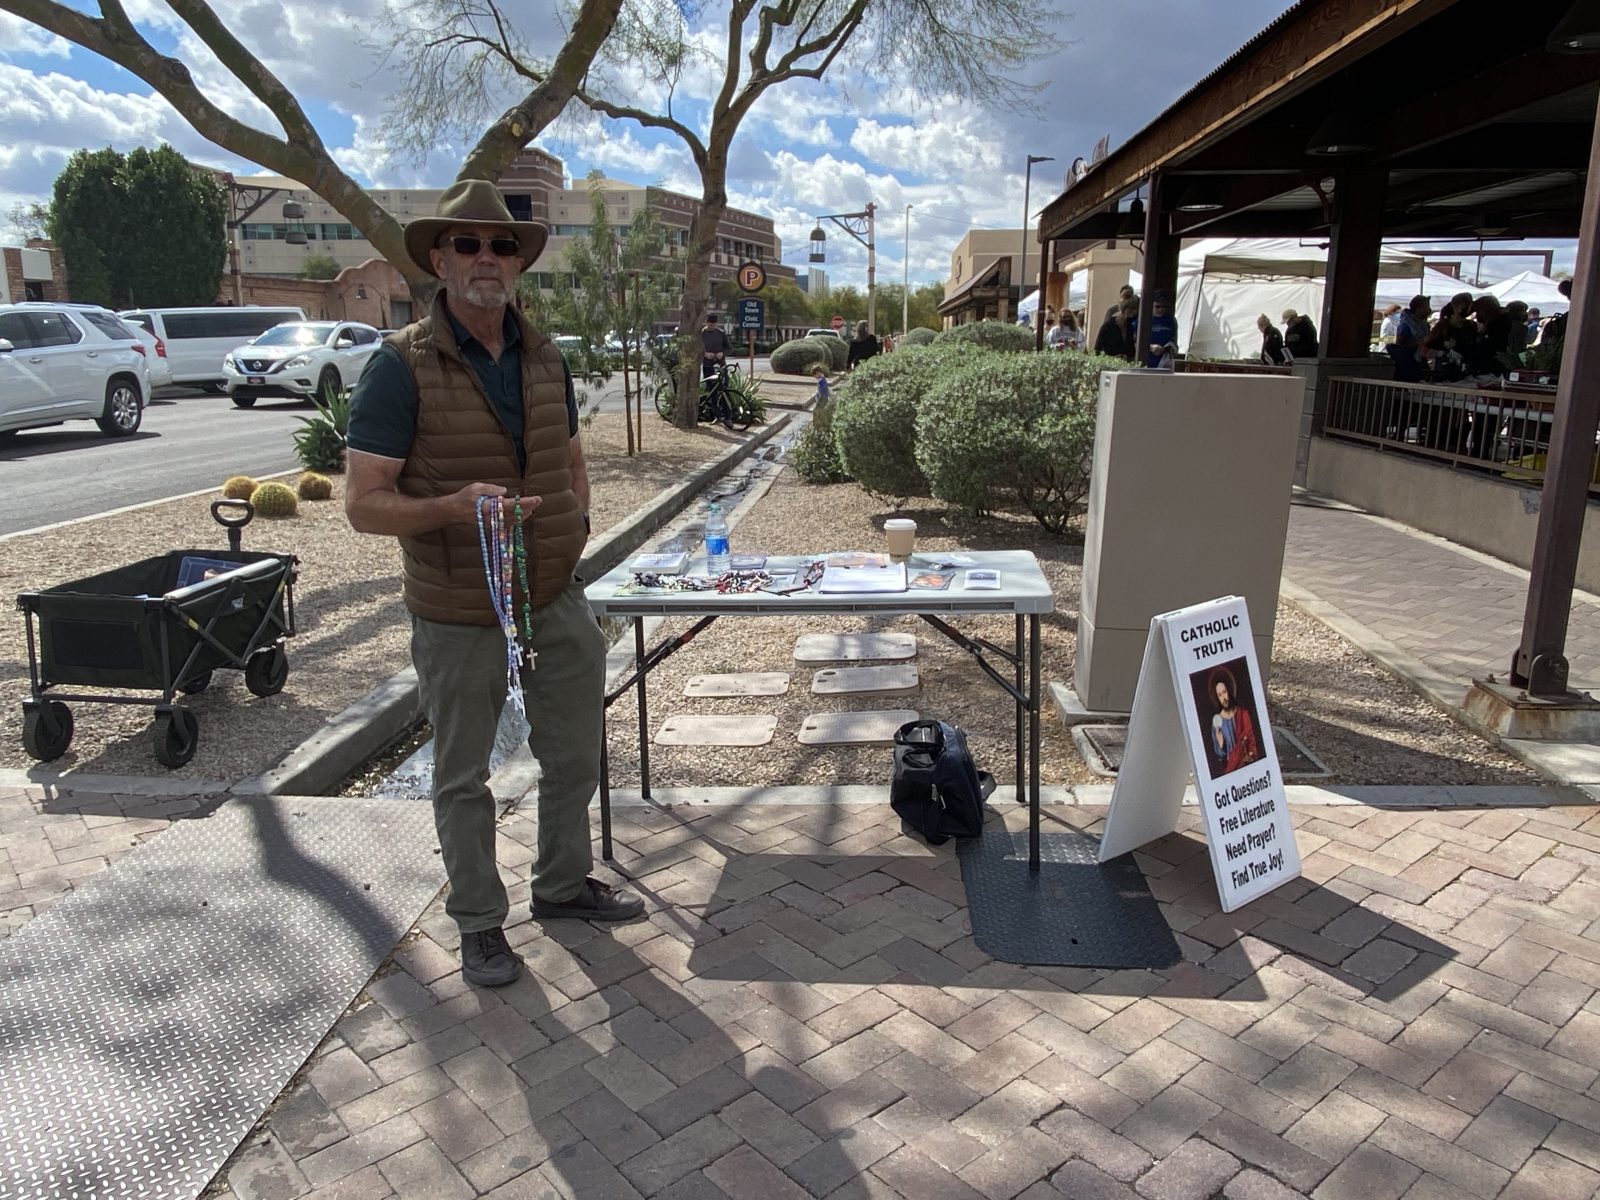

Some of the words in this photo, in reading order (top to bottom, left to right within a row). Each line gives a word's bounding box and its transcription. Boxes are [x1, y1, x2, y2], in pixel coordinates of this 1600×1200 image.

[744, 270, 760, 287] P
[1180, 614, 1240, 643] CATHOLIC
[1192, 636, 1234, 660] TRUTH
[1214, 789, 1231, 809] Got
[1231, 770, 1271, 802] Questions?
[1219, 816, 1239, 835] Free
[1238, 799, 1275, 826] Literature
[1225, 836, 1247, 861] Need
[1246, 822, 1276, 851] Prayer?
[1231, 865, 1250, 889] Find
[1248, 862, 1267, 880] True
[1268, 848, 1284, 871] Joy!
